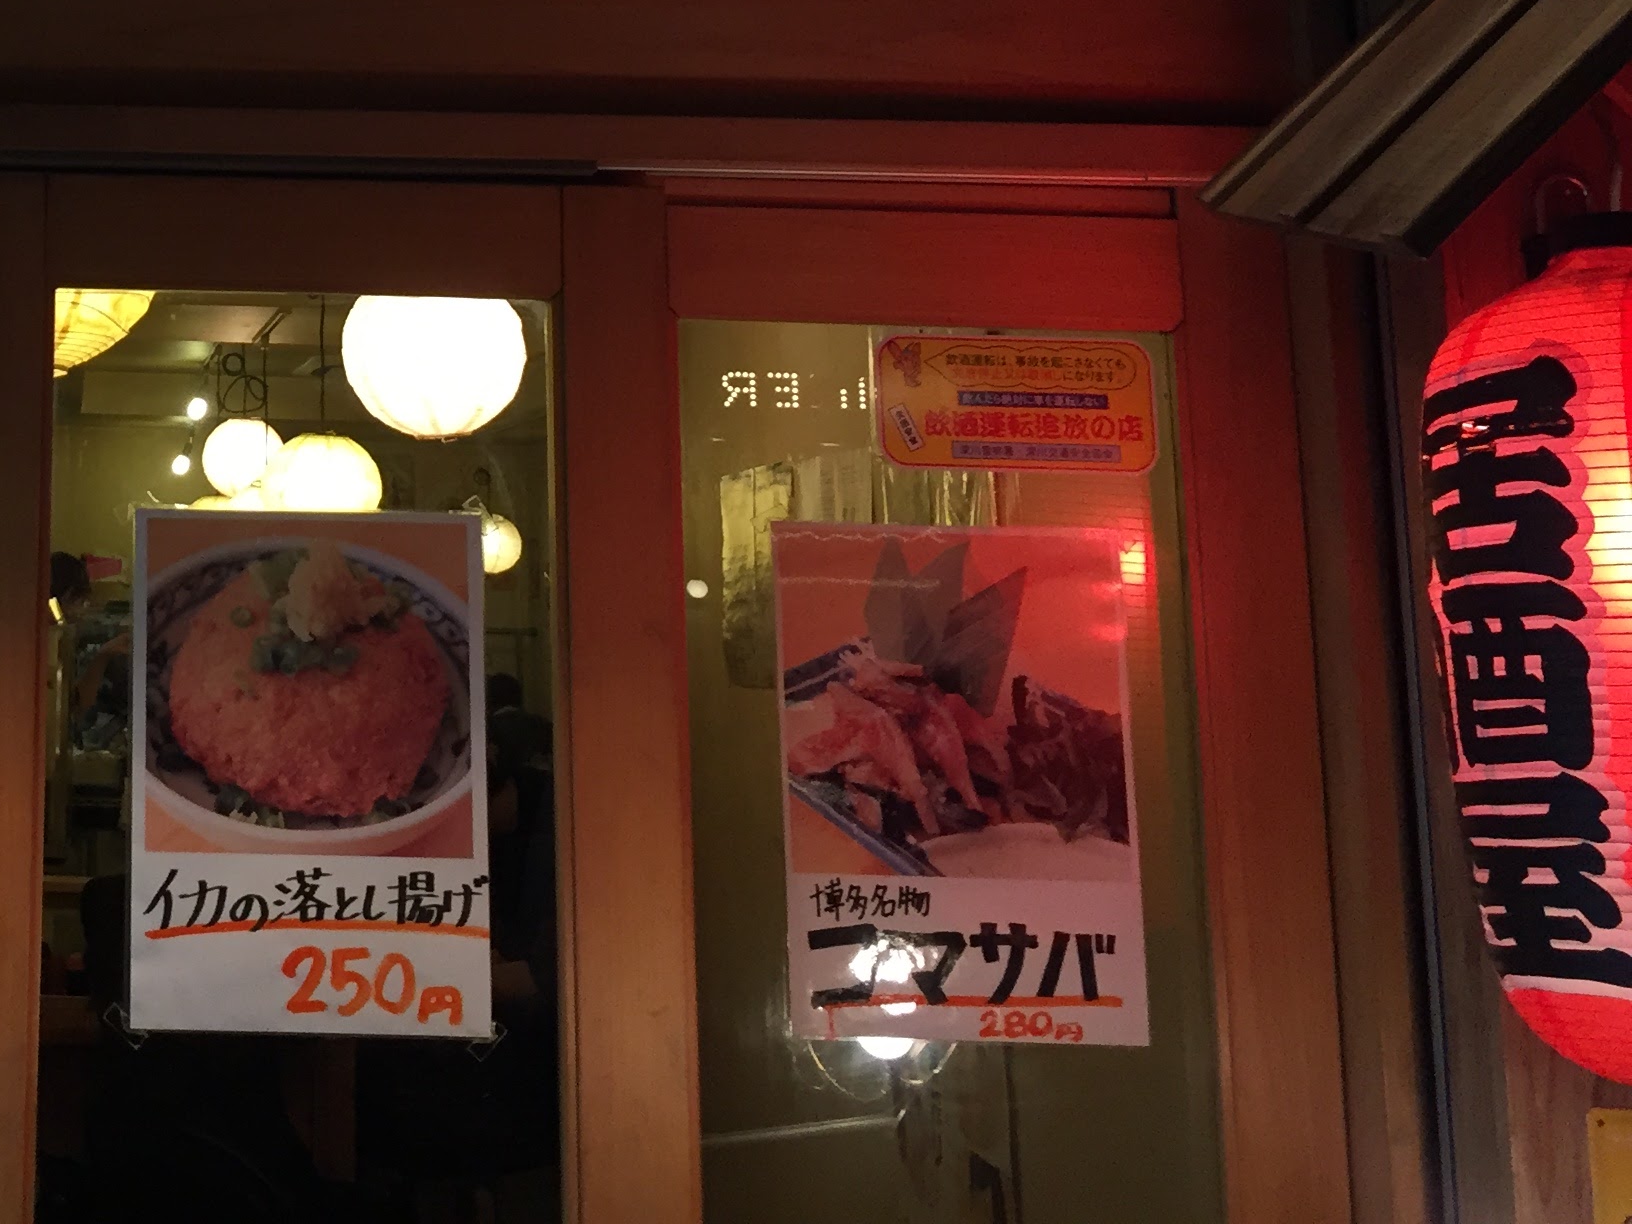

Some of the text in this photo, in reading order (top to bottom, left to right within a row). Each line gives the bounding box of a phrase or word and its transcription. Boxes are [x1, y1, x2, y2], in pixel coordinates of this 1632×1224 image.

[924, 407, 1144, 442] 飲酒運転追放の店
[143, 867, 490, 932] イカの落とし揚げ
[809, 877, 931, 921] 博多名物
[280, 944, 463, 1026] 250円
[979, 1009, 1084, 1043] 280円
